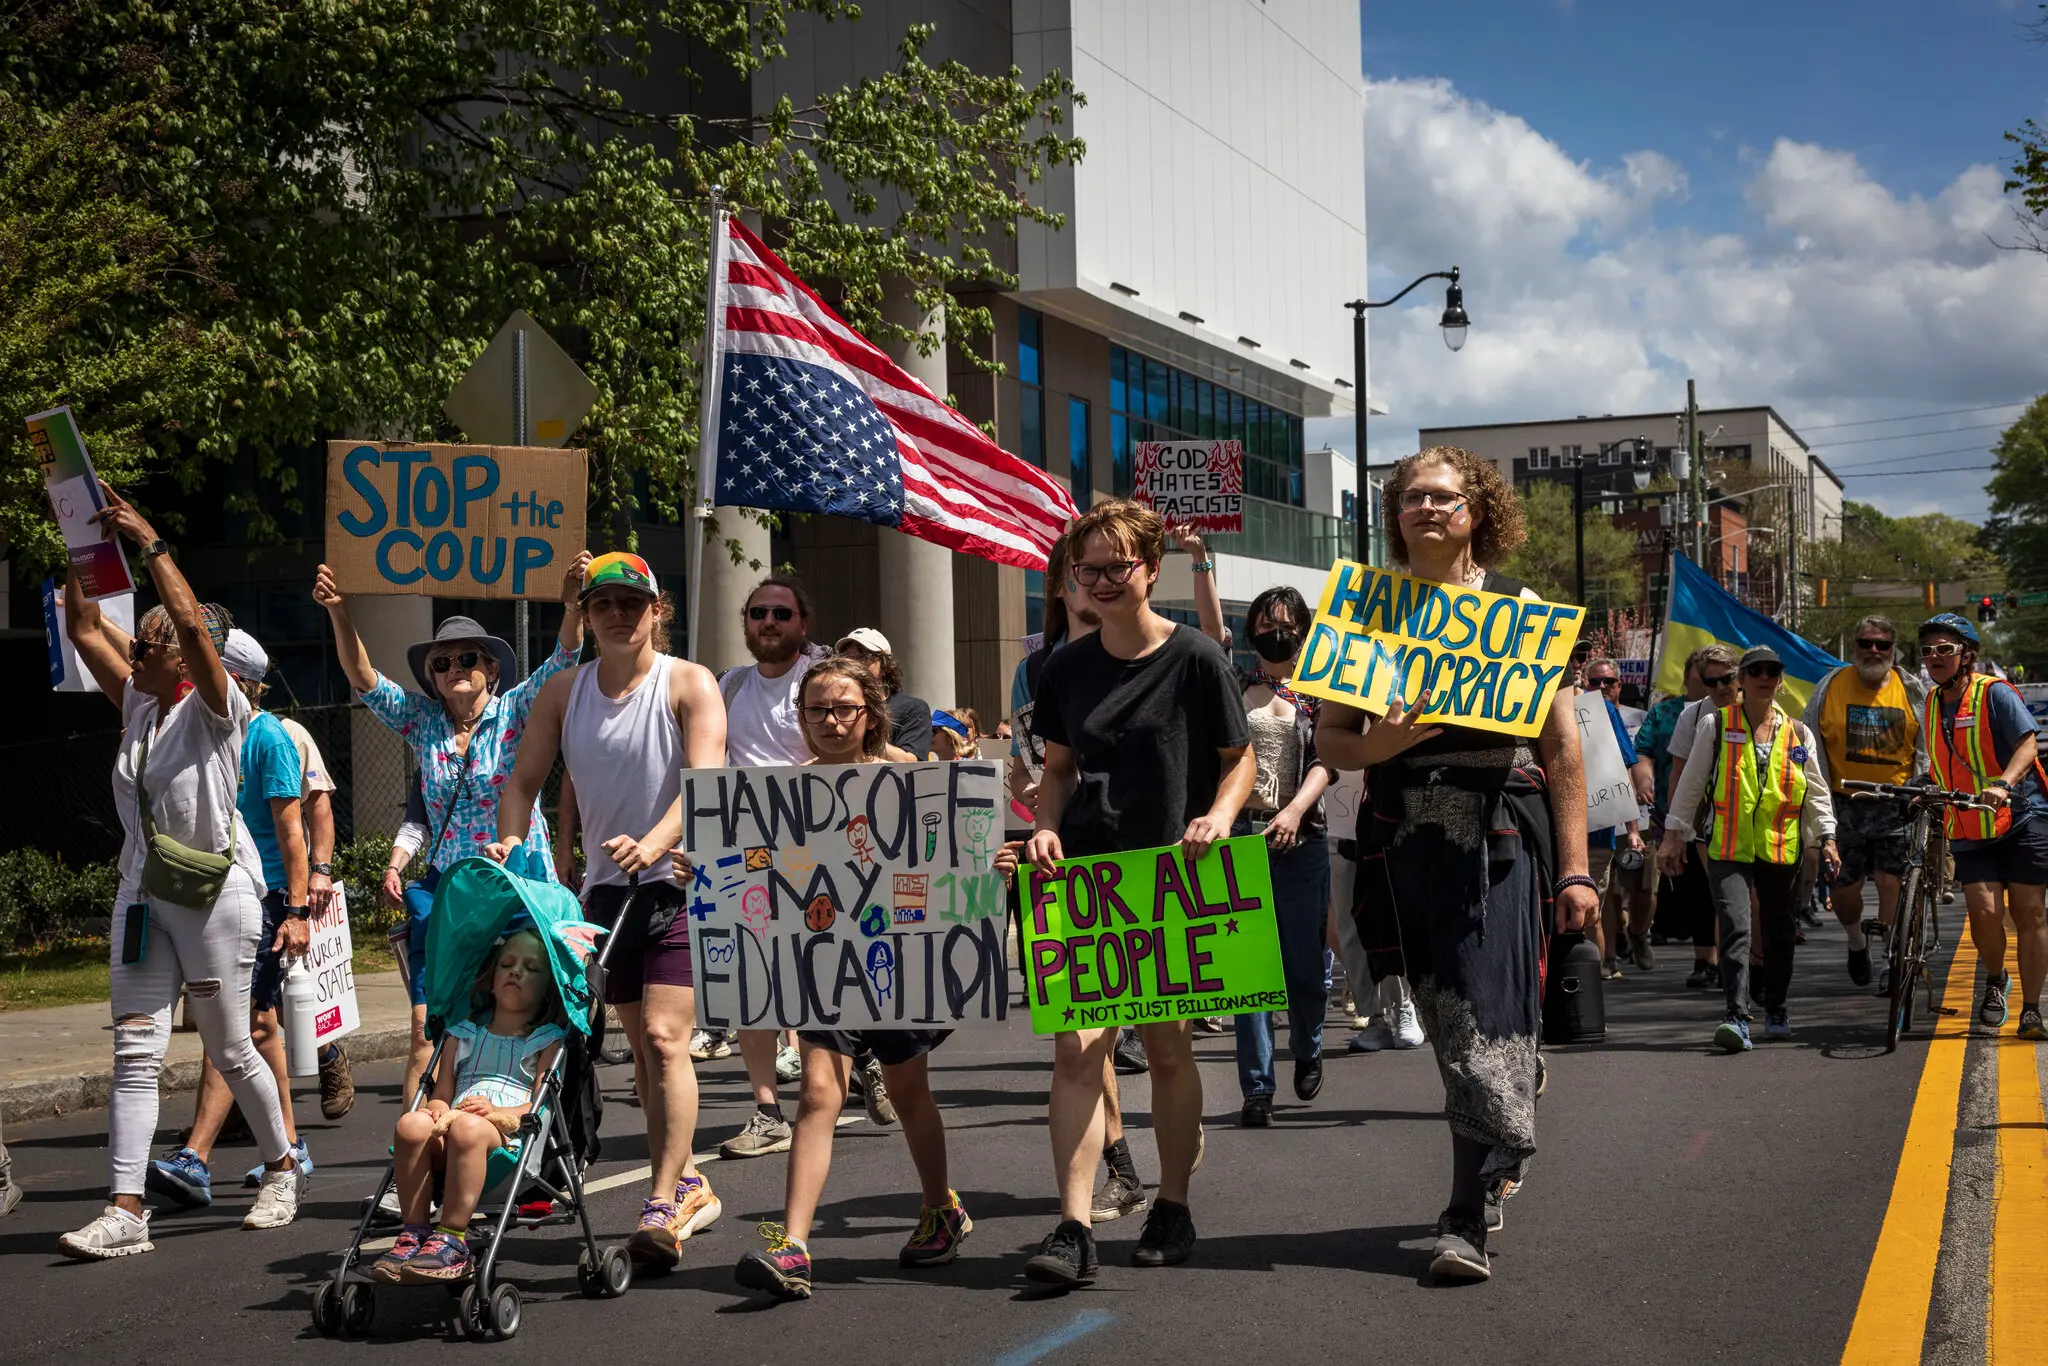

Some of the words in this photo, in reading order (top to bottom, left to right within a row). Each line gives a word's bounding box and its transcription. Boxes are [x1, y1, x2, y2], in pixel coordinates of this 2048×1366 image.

[337, 445, 500, 538] STOP
[500, 490, 564, 529] the
[1149, 471, 1222, 491] HATES
[1157, 446, 1208, 470] GOD
[1153, 495, 1242, 516] FASCISTS
[375, 528, 554, 595] COUP
[1327, 565, 1481, 650] HANDS
[1480, 597, 1579, 660] OFF
[1298, 622, 1565, 725] DEMOCRACY
[685, 769, 860, 852] HANDS
[866, 761, 996, 868] OFF
[767, 859, 882, 922] MY
[1029, 861, 1139, 935] FOR
[1152, 844, 1262, 922] ALL
[310, 936, 343, 969] HURCH
[317, 958, 354, 1003] STATE
[698, 917, 1010, 1028] EDUCATION
[1031, 922, 1225, 1006] PEOPLE
[1080, 1002, 1121, 1026] NOT
[1124, 999, 1173, 1021] JUST
[1177, 990, 1288, 1015] BILLIONAIRES
